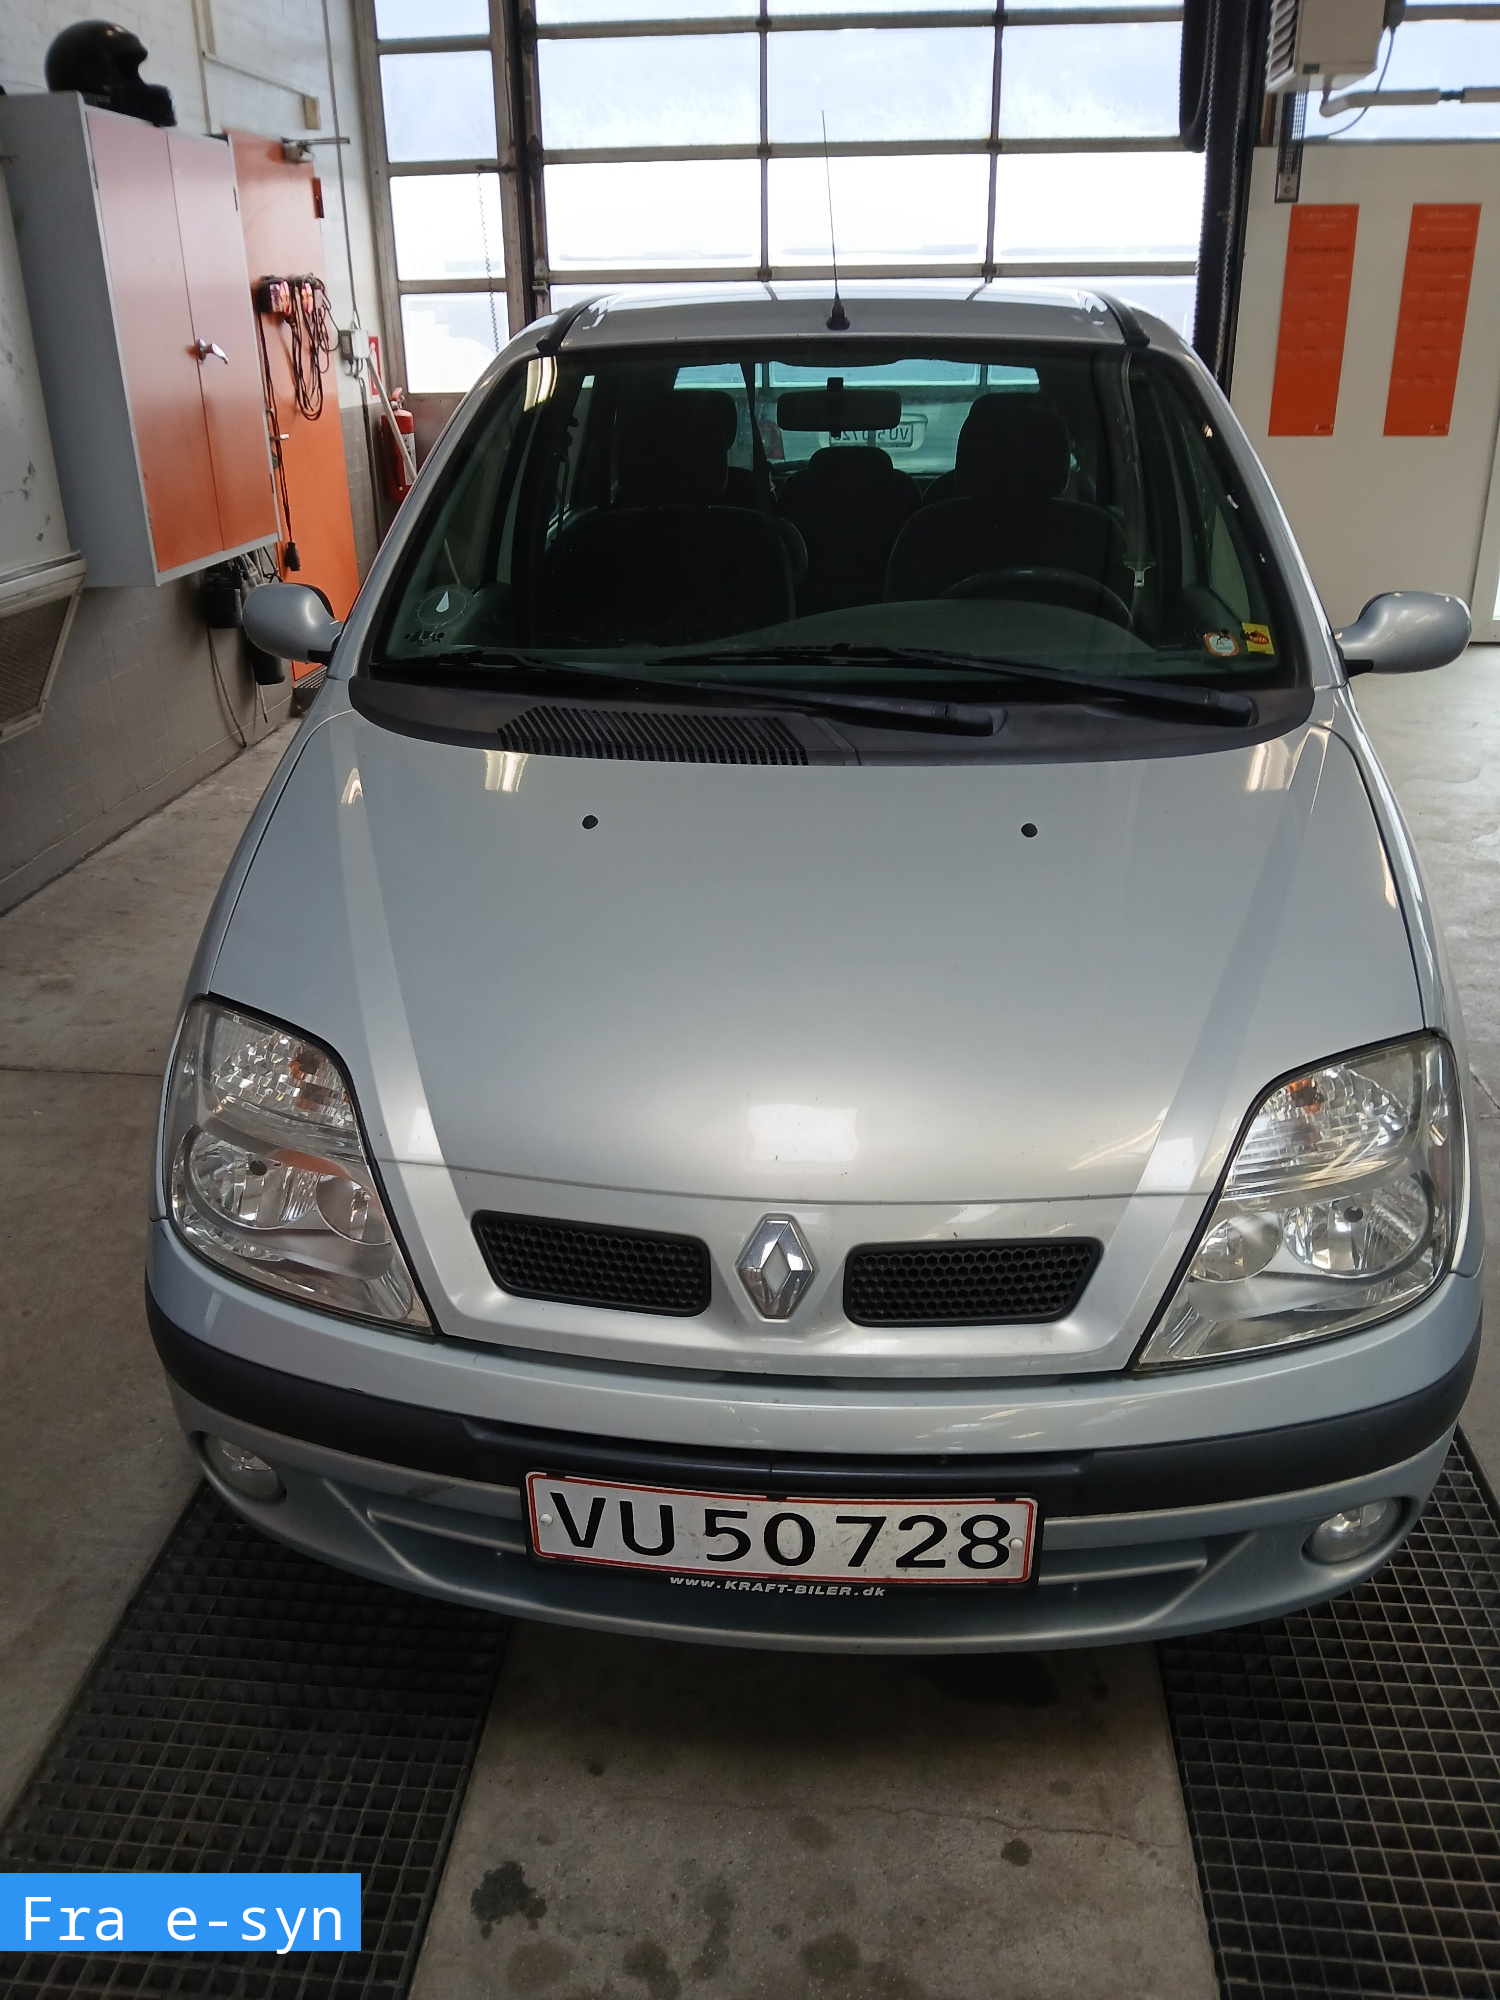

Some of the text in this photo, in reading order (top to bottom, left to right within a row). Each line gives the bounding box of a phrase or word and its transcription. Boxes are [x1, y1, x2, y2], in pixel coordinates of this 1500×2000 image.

[549, 1491, 1012, 1570] VU 50 728
[669, 1576, 886, 1597] www.KRAFT-BILER.dk
